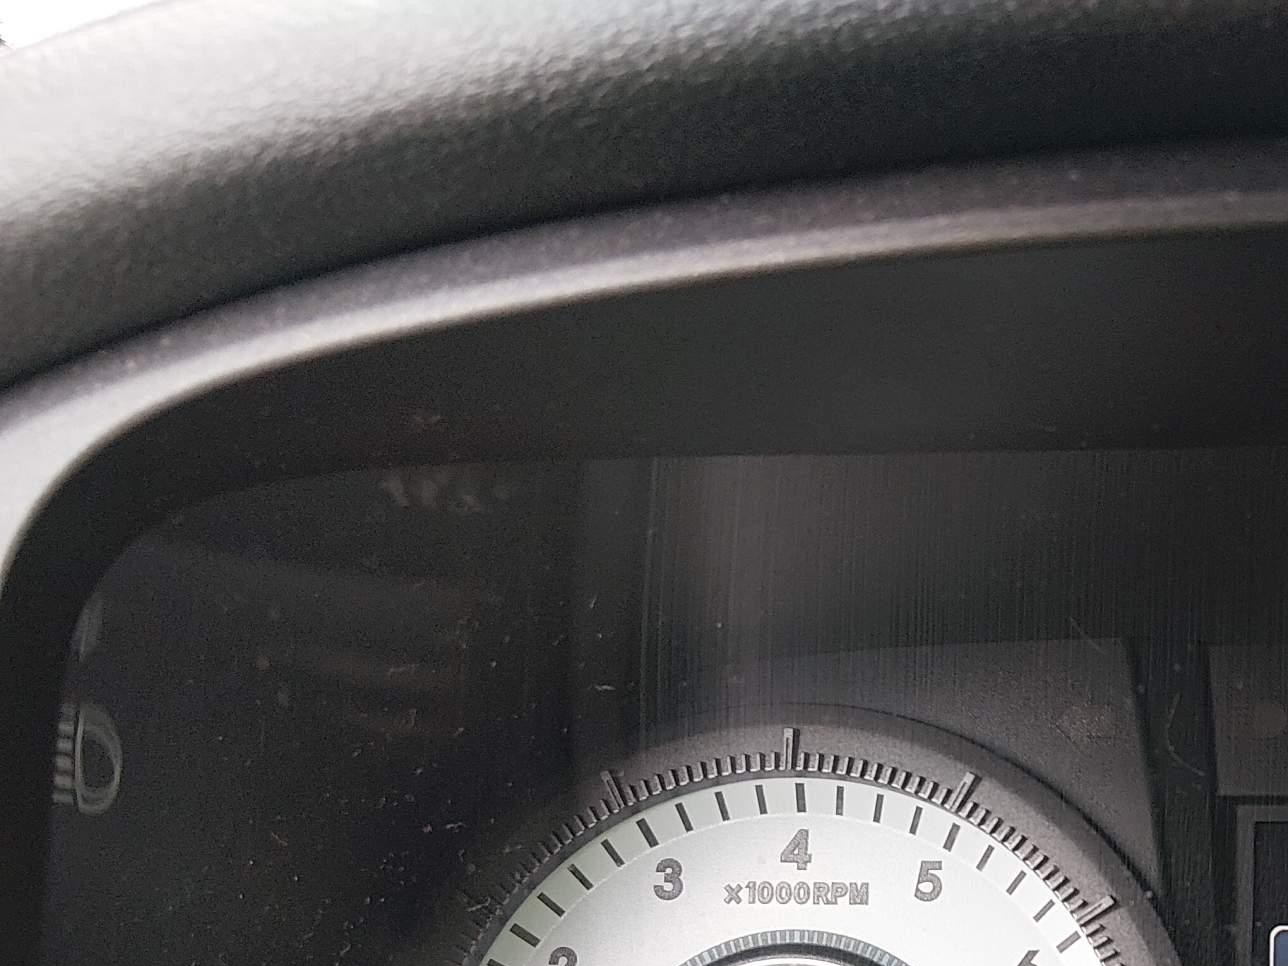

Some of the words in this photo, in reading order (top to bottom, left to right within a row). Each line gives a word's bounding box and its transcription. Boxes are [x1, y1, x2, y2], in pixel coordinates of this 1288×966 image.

[780, 829, 812, 871] 4
[653, 858, 684, 901] 3
[914, 860, 943, 902] 5
